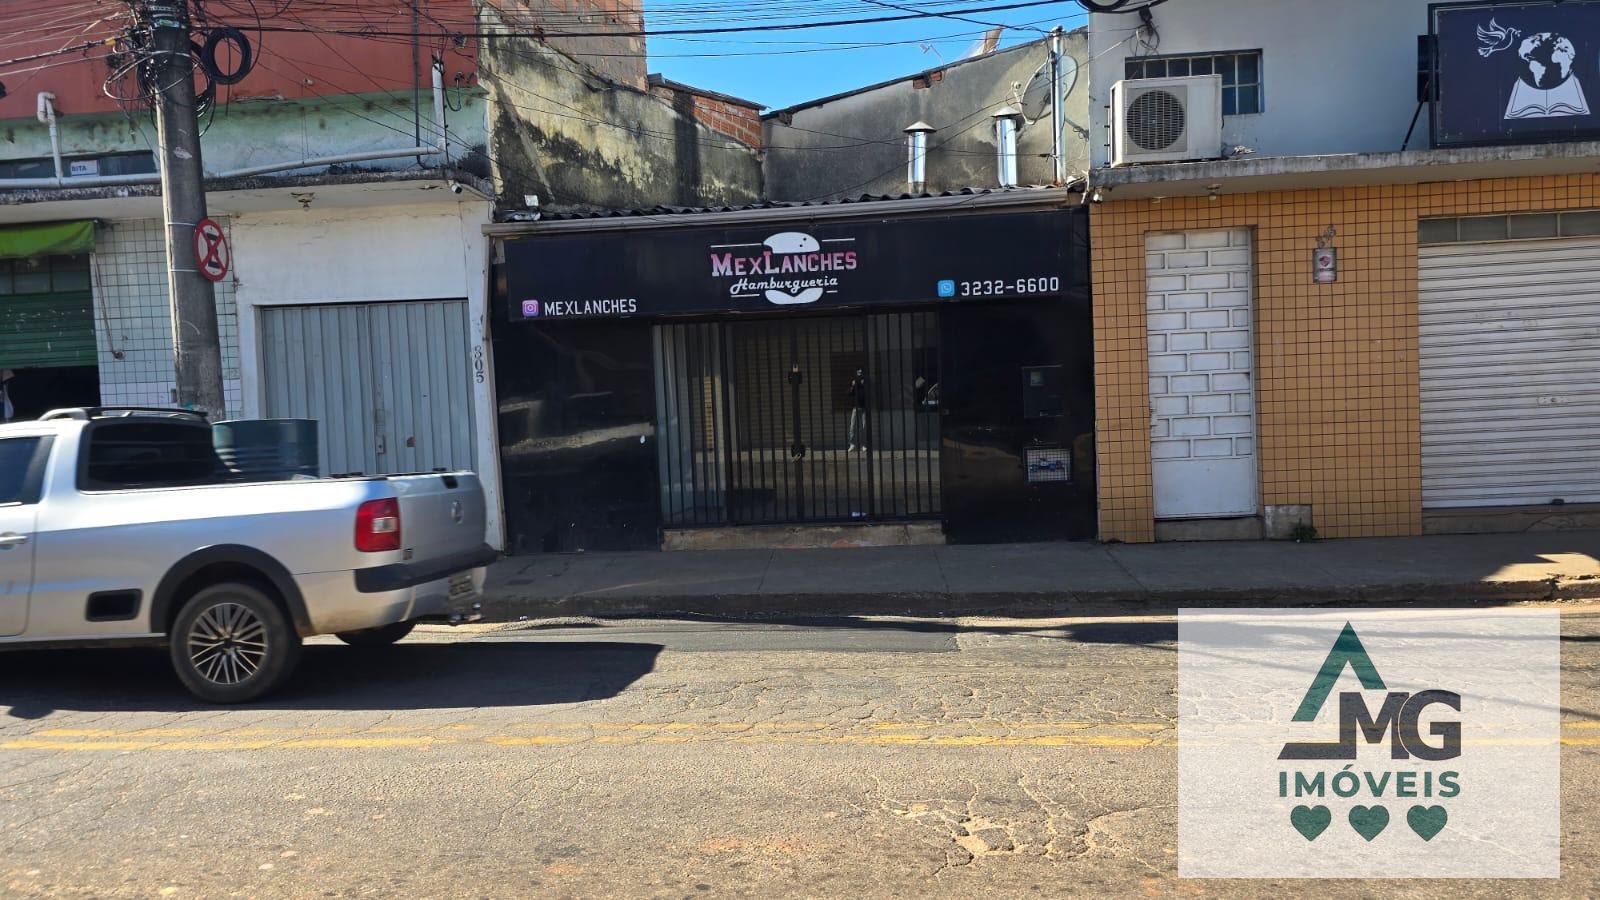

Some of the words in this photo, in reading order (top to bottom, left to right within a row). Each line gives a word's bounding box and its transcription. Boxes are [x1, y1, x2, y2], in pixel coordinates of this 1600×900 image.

[729, 276, 838, 294] Hamburgueria
[960, 277, 1060, 296] 3232-6600
[544, 299, 637, 316] MEXLANCHES
